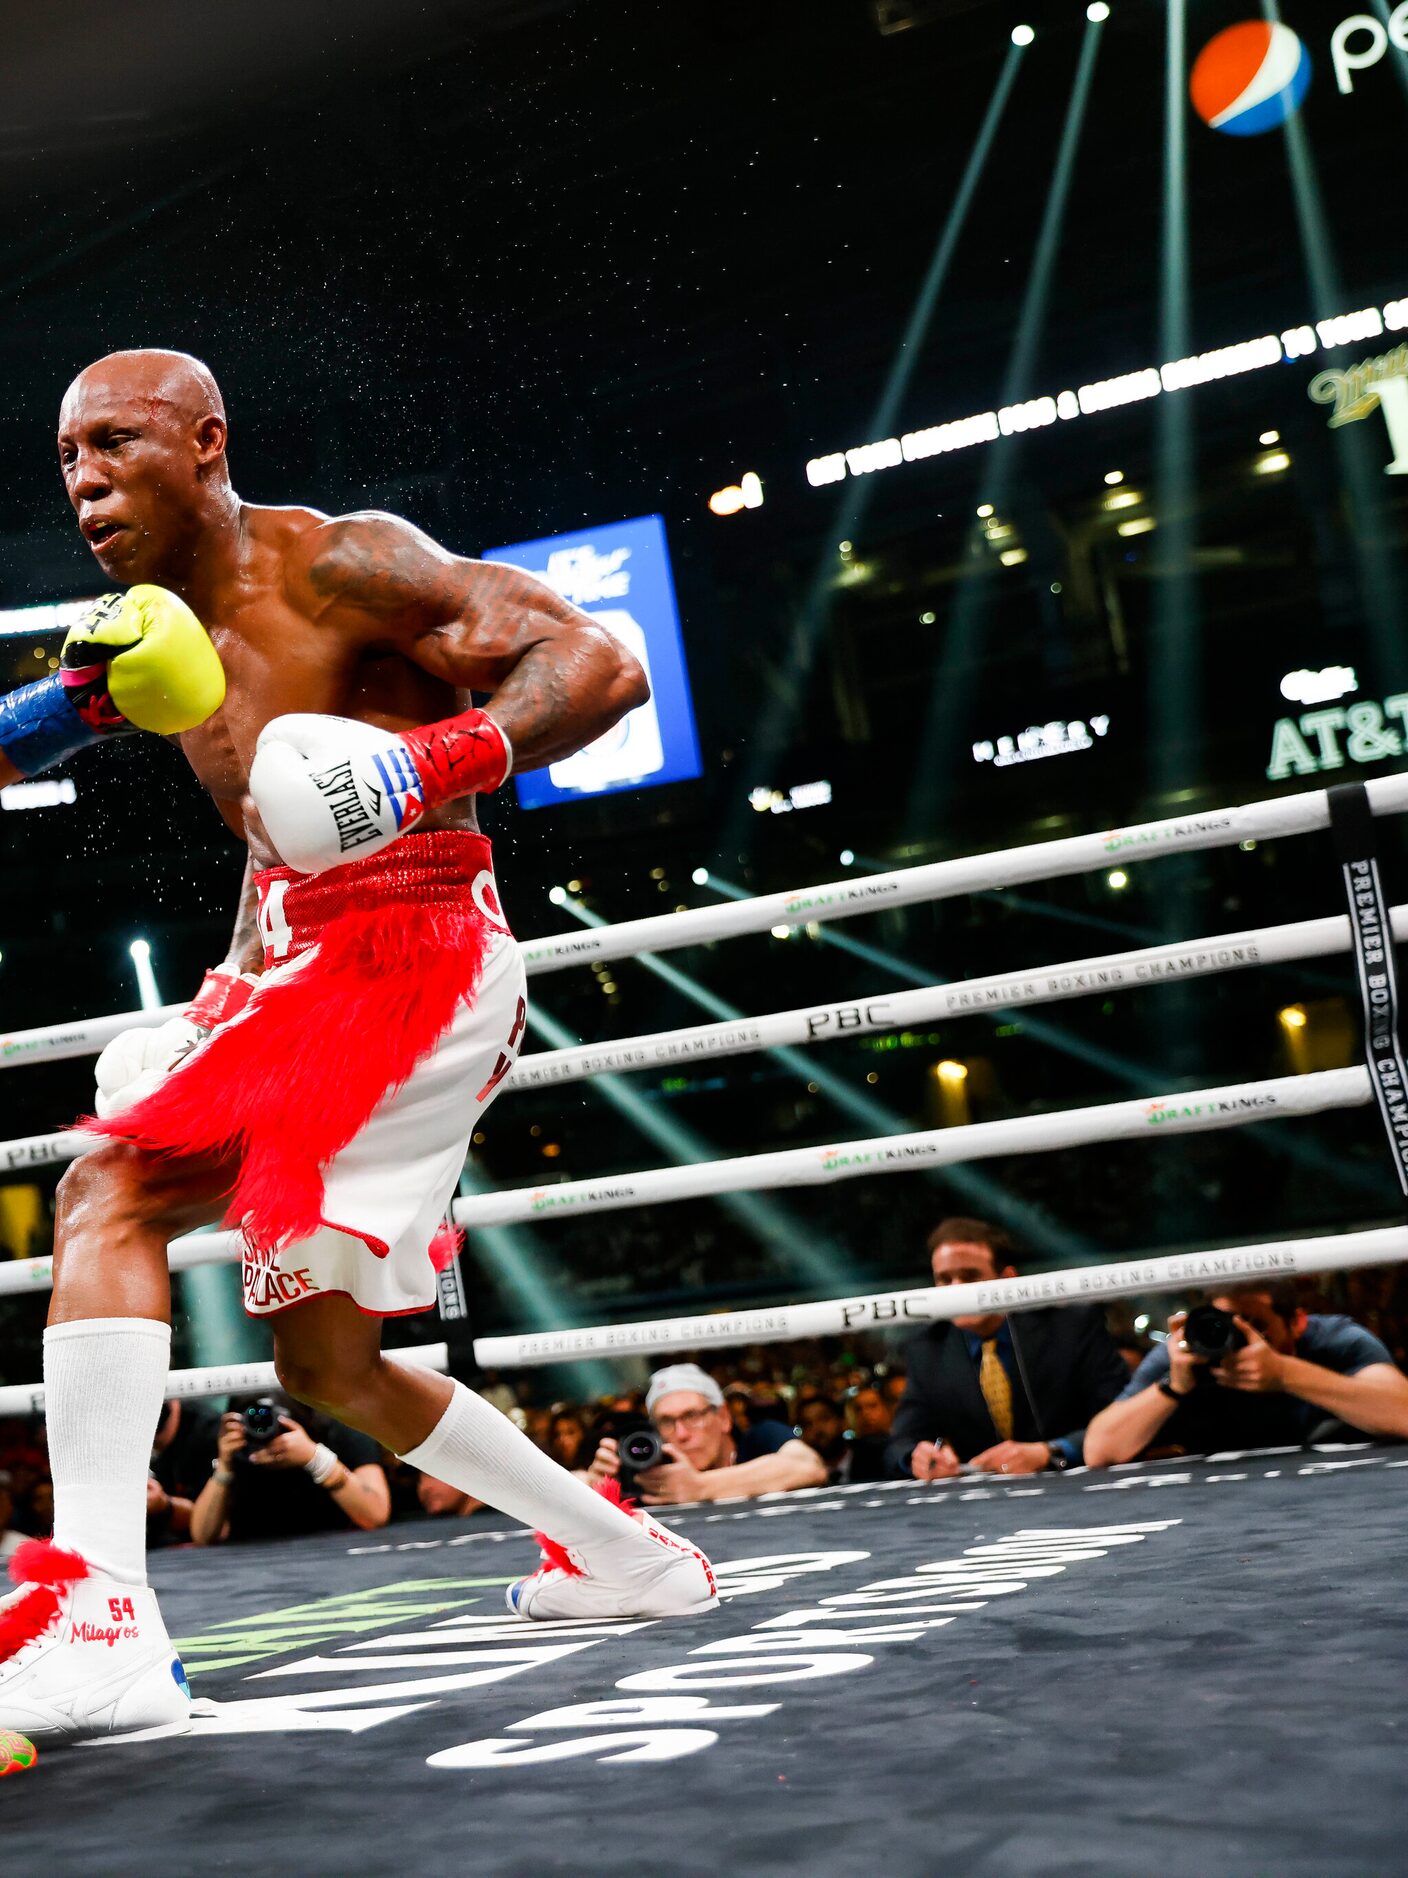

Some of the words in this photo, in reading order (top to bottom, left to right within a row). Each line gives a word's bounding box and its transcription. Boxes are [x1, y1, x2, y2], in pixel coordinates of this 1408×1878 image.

[309, 755, 383, 853] EVERLAST
[1048, 969, 1124, 995] BOXING
[1136, 945, 1260, 979] CHAMPIONS
[1351, 859, 1385, 966] PREMIER
[1368, 974, 1390, 1050] BOXING
[806, 1003, 894, 1039] PBC
[507, 1064, 571, 1087] REMIER
[655, 1030, 760, 1061] CHAMPIONS
[1148, 1096, 1277, 1125] DRAFTKINGS
[841, 1297, 932, 1329] PBC
[108, 1597, 135, 1622] 54
[70, 1621, 139, 1646] Milagros
[425, 1518, 1183, 1768] SPORTSBOOK
